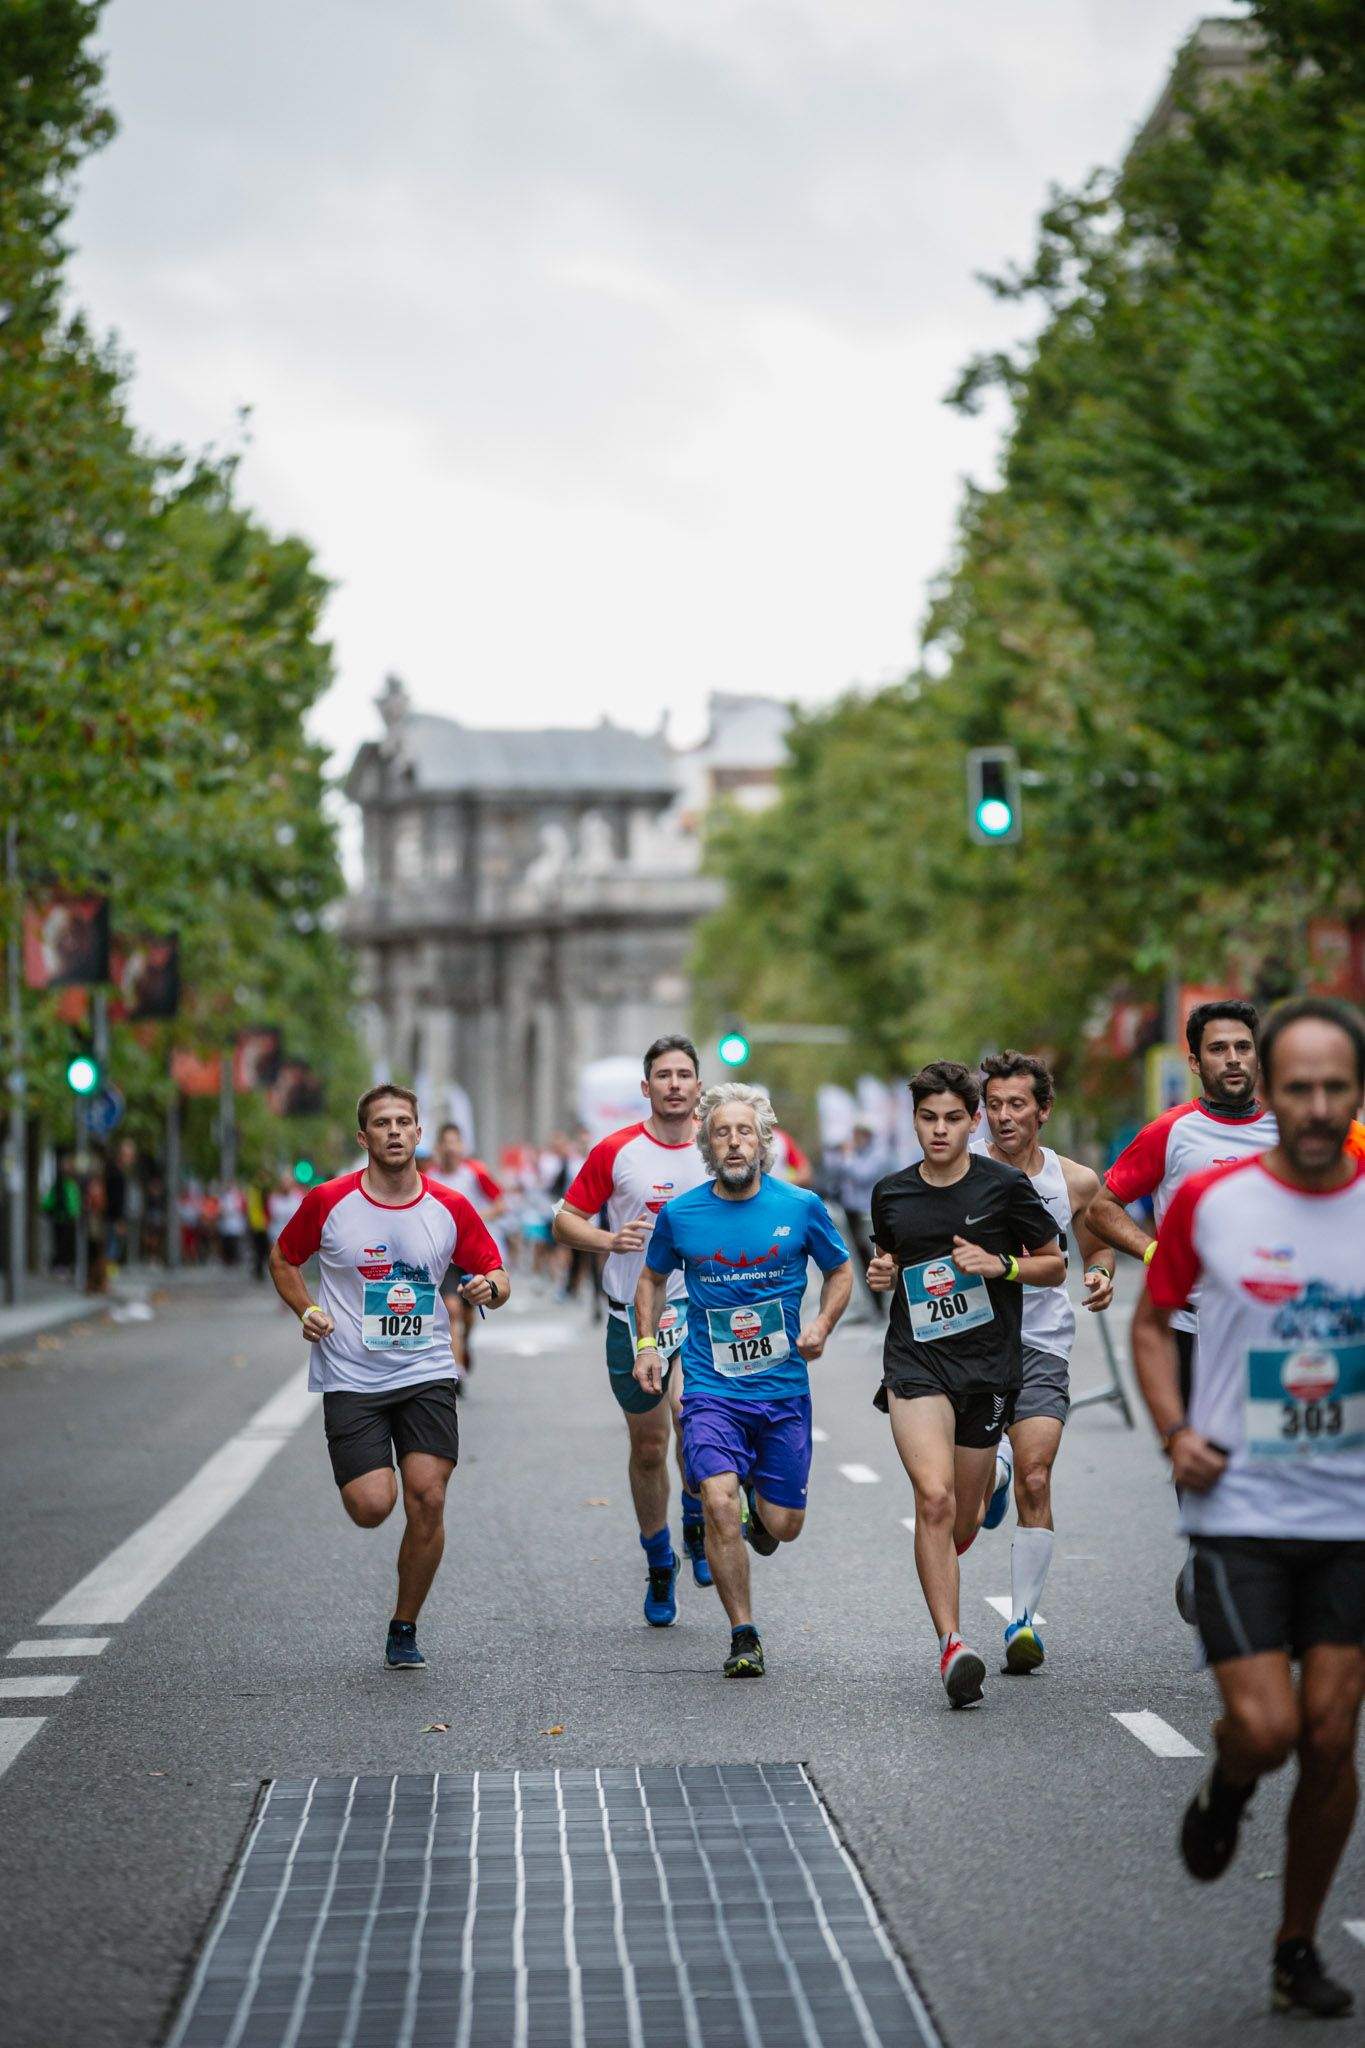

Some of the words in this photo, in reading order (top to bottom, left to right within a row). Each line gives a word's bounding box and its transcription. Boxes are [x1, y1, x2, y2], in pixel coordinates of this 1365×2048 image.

[723, 1272, 766, 1281] MARATHON
[927, 1293, 968, 1323] 260
[379, 1315, 422, 1336] 1029
[728, 1336, 772, 1362] 1128
[1282, 1402, 1342, 1438] 303
